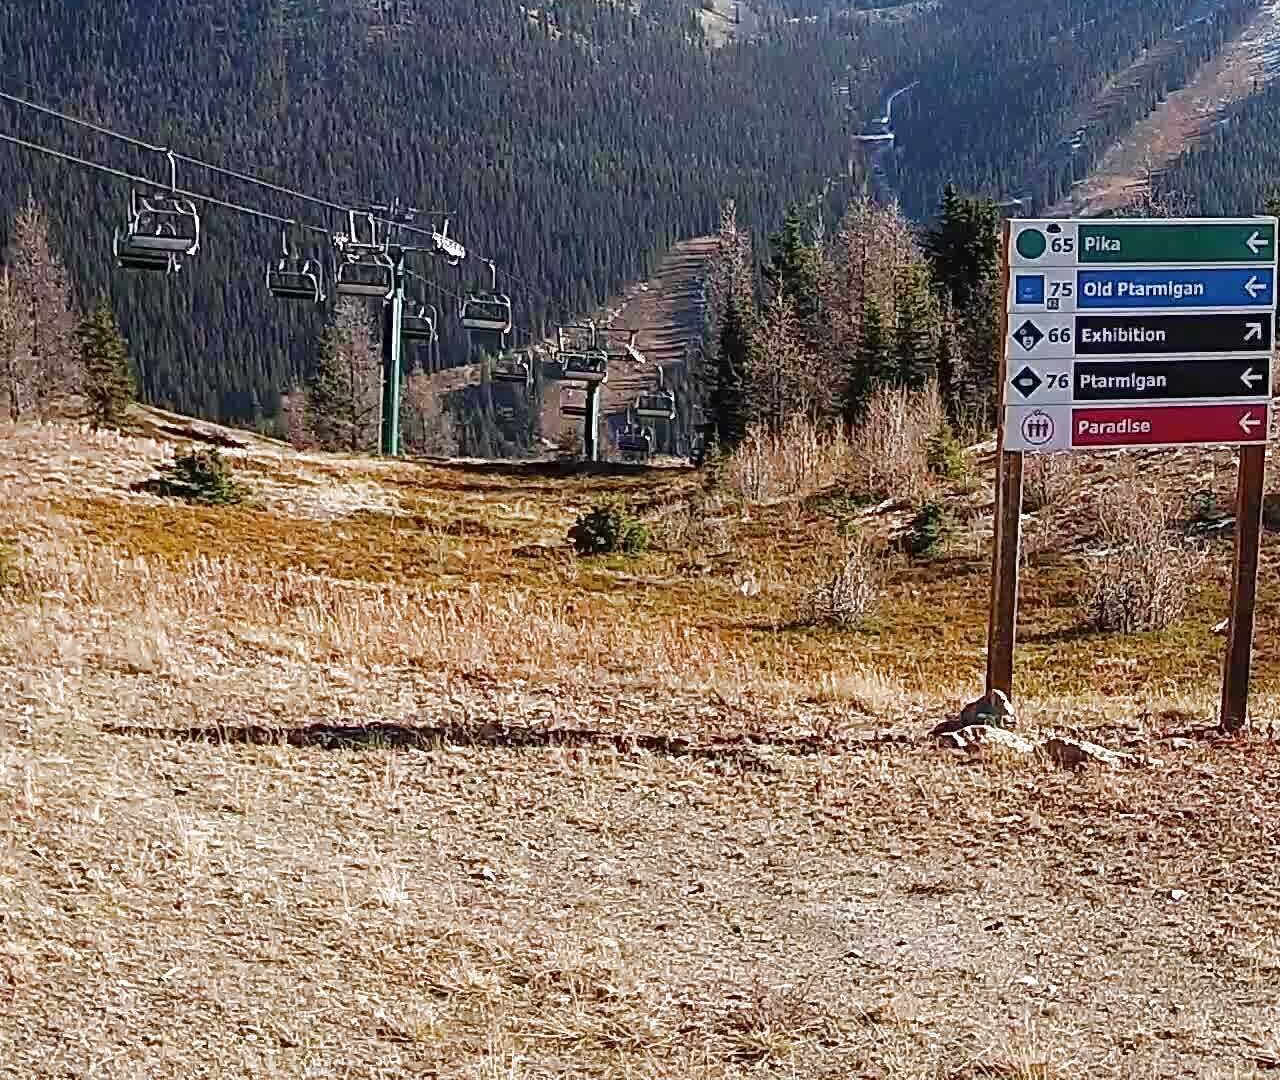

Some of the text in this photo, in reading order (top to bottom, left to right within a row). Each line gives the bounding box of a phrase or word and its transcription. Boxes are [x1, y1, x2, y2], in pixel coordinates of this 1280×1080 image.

[1051, 236, 1121, 253] 65 Pika
[1050, 281, 1204, 299] 75 Old Ptarmigan
[1048, 327, 1166, 343] 66 Exhibition
[1046, 373, 1167, 391] 76 Ptarmigan
[1078, 418, 1151, 435] Paradise
